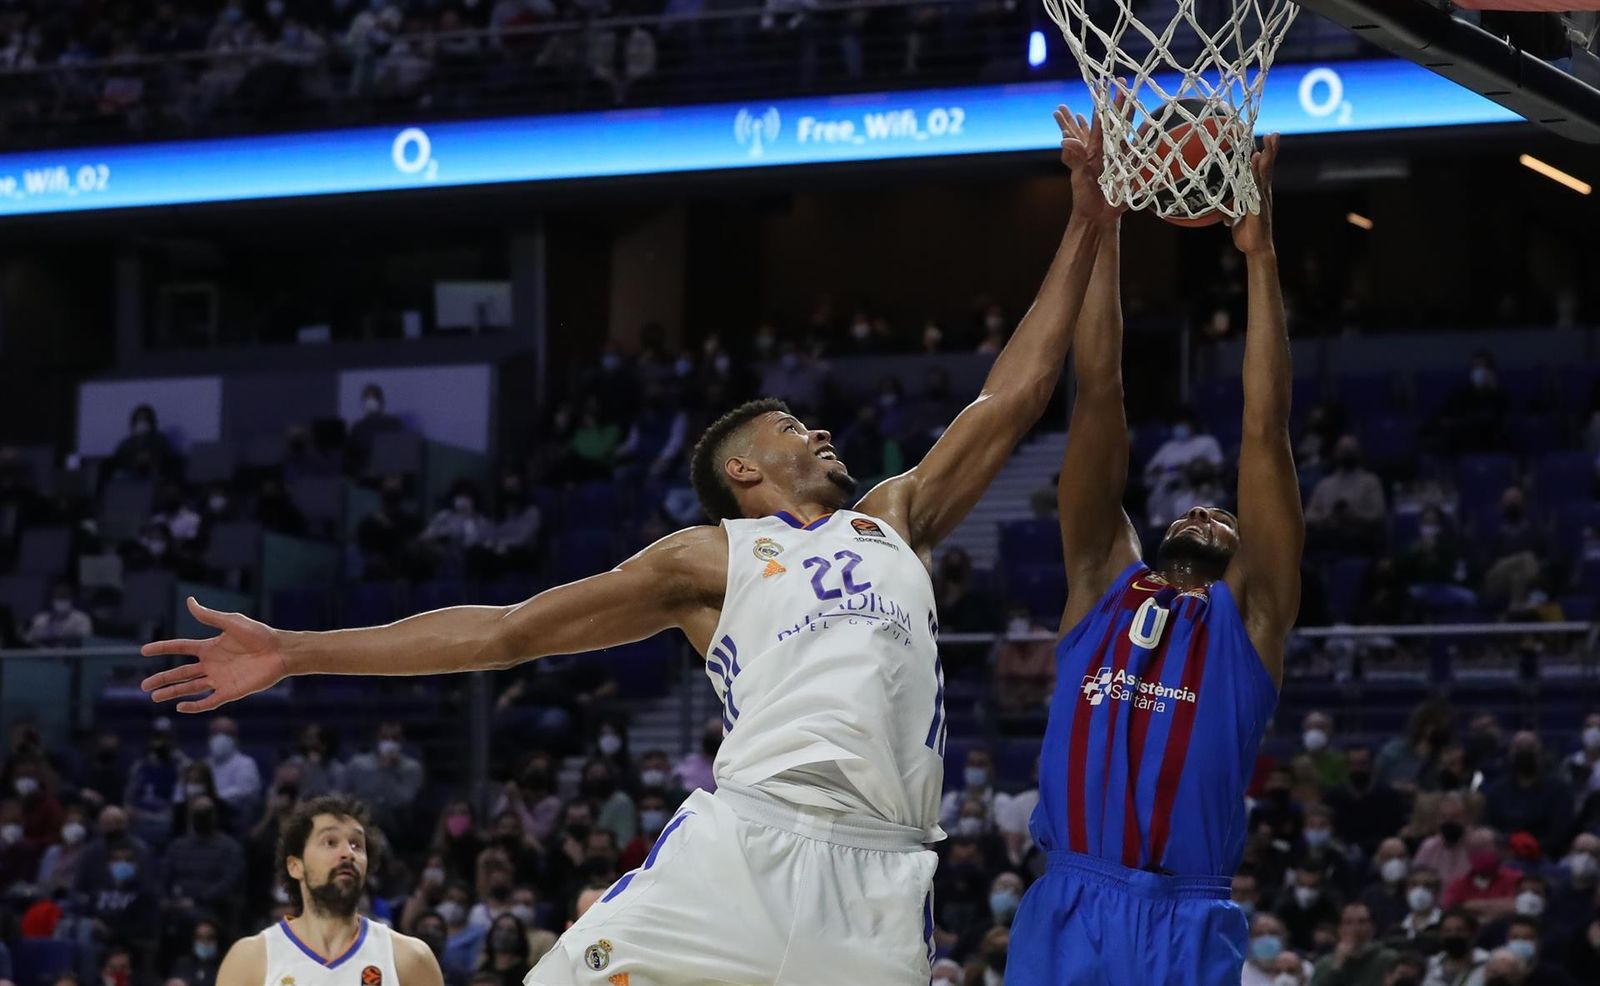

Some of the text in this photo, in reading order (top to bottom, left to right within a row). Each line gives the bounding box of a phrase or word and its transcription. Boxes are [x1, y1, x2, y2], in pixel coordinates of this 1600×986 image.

[803, 550, 872, 600] 22
[1128, 597, 1170, 649] 0
[1110, 684, 1166, 713] Satària
[1113, 669, 1196, 703] Asistència
